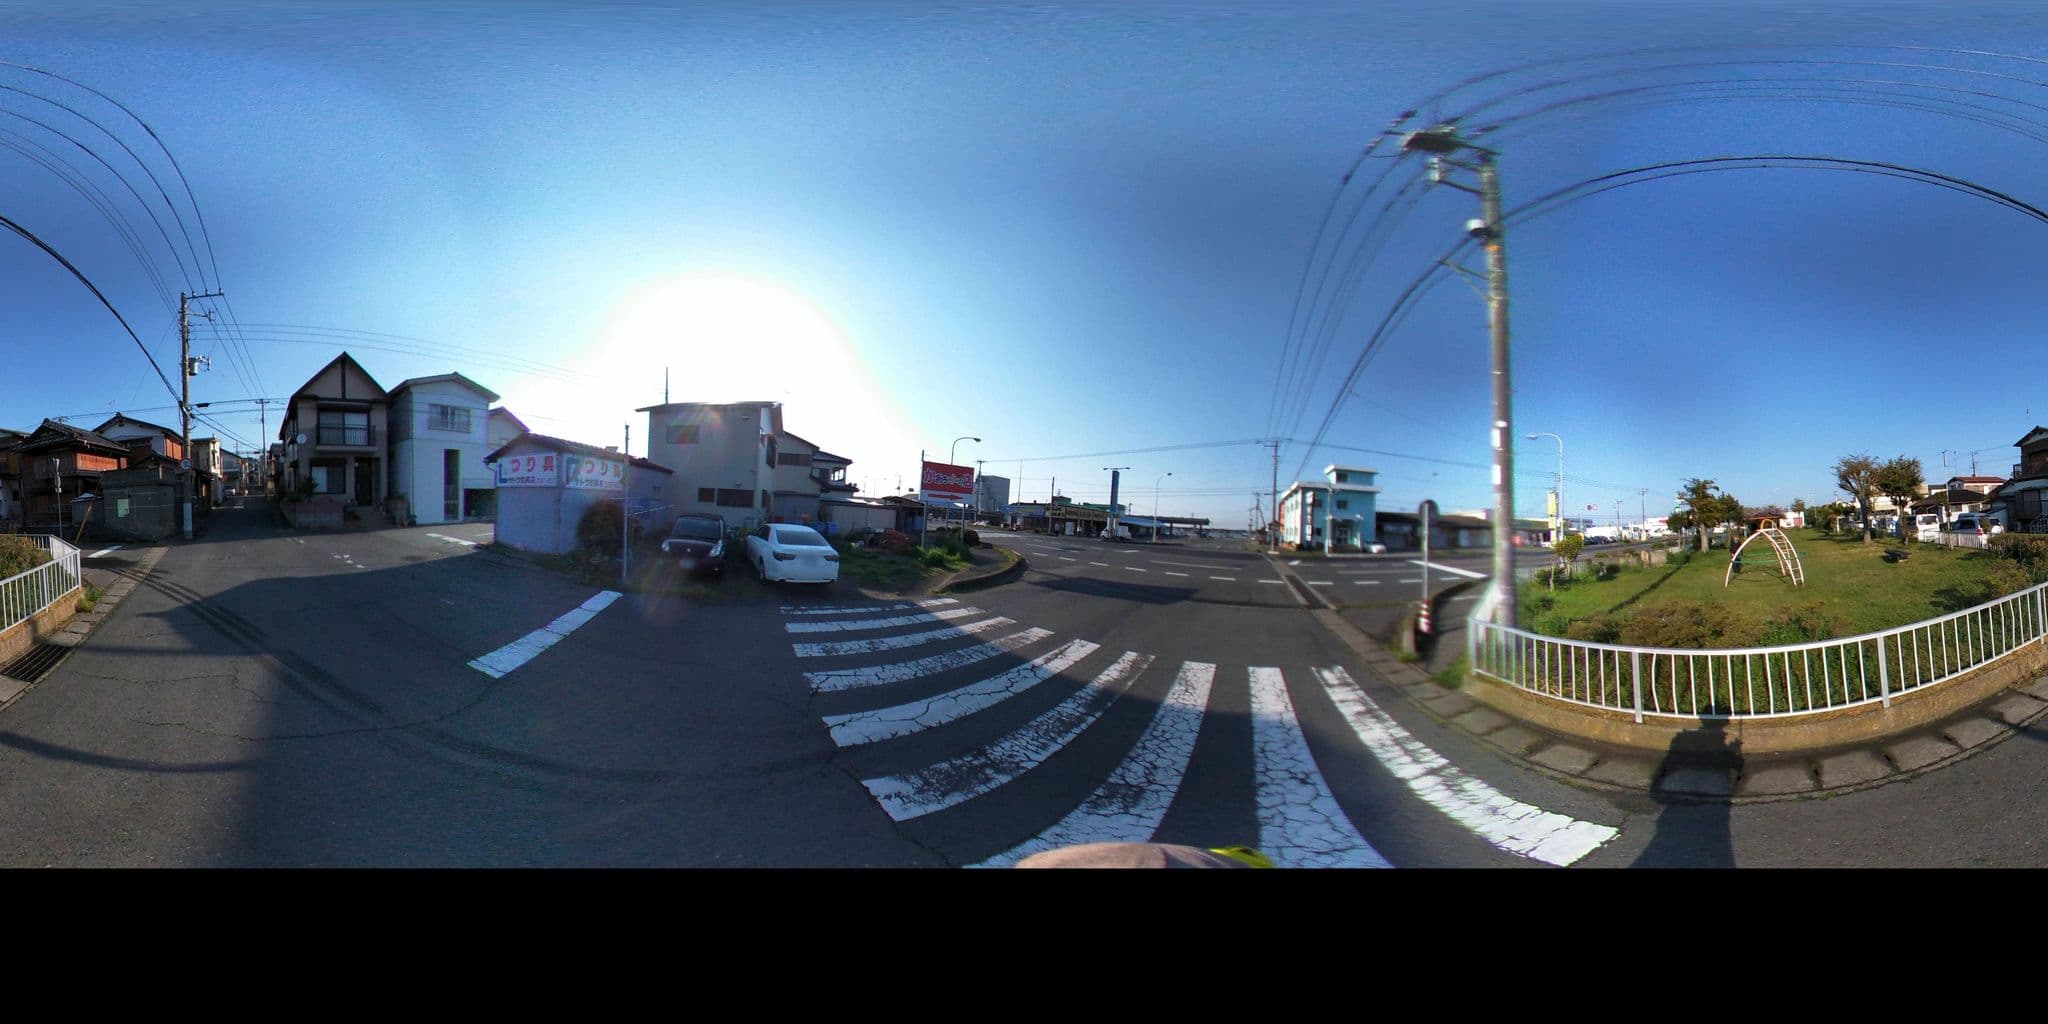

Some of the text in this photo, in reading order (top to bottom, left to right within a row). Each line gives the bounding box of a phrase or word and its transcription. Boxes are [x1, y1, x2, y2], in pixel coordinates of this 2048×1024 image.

[512, 456, 554, 472] つり具
[584, 459, 621, 477] つり具
